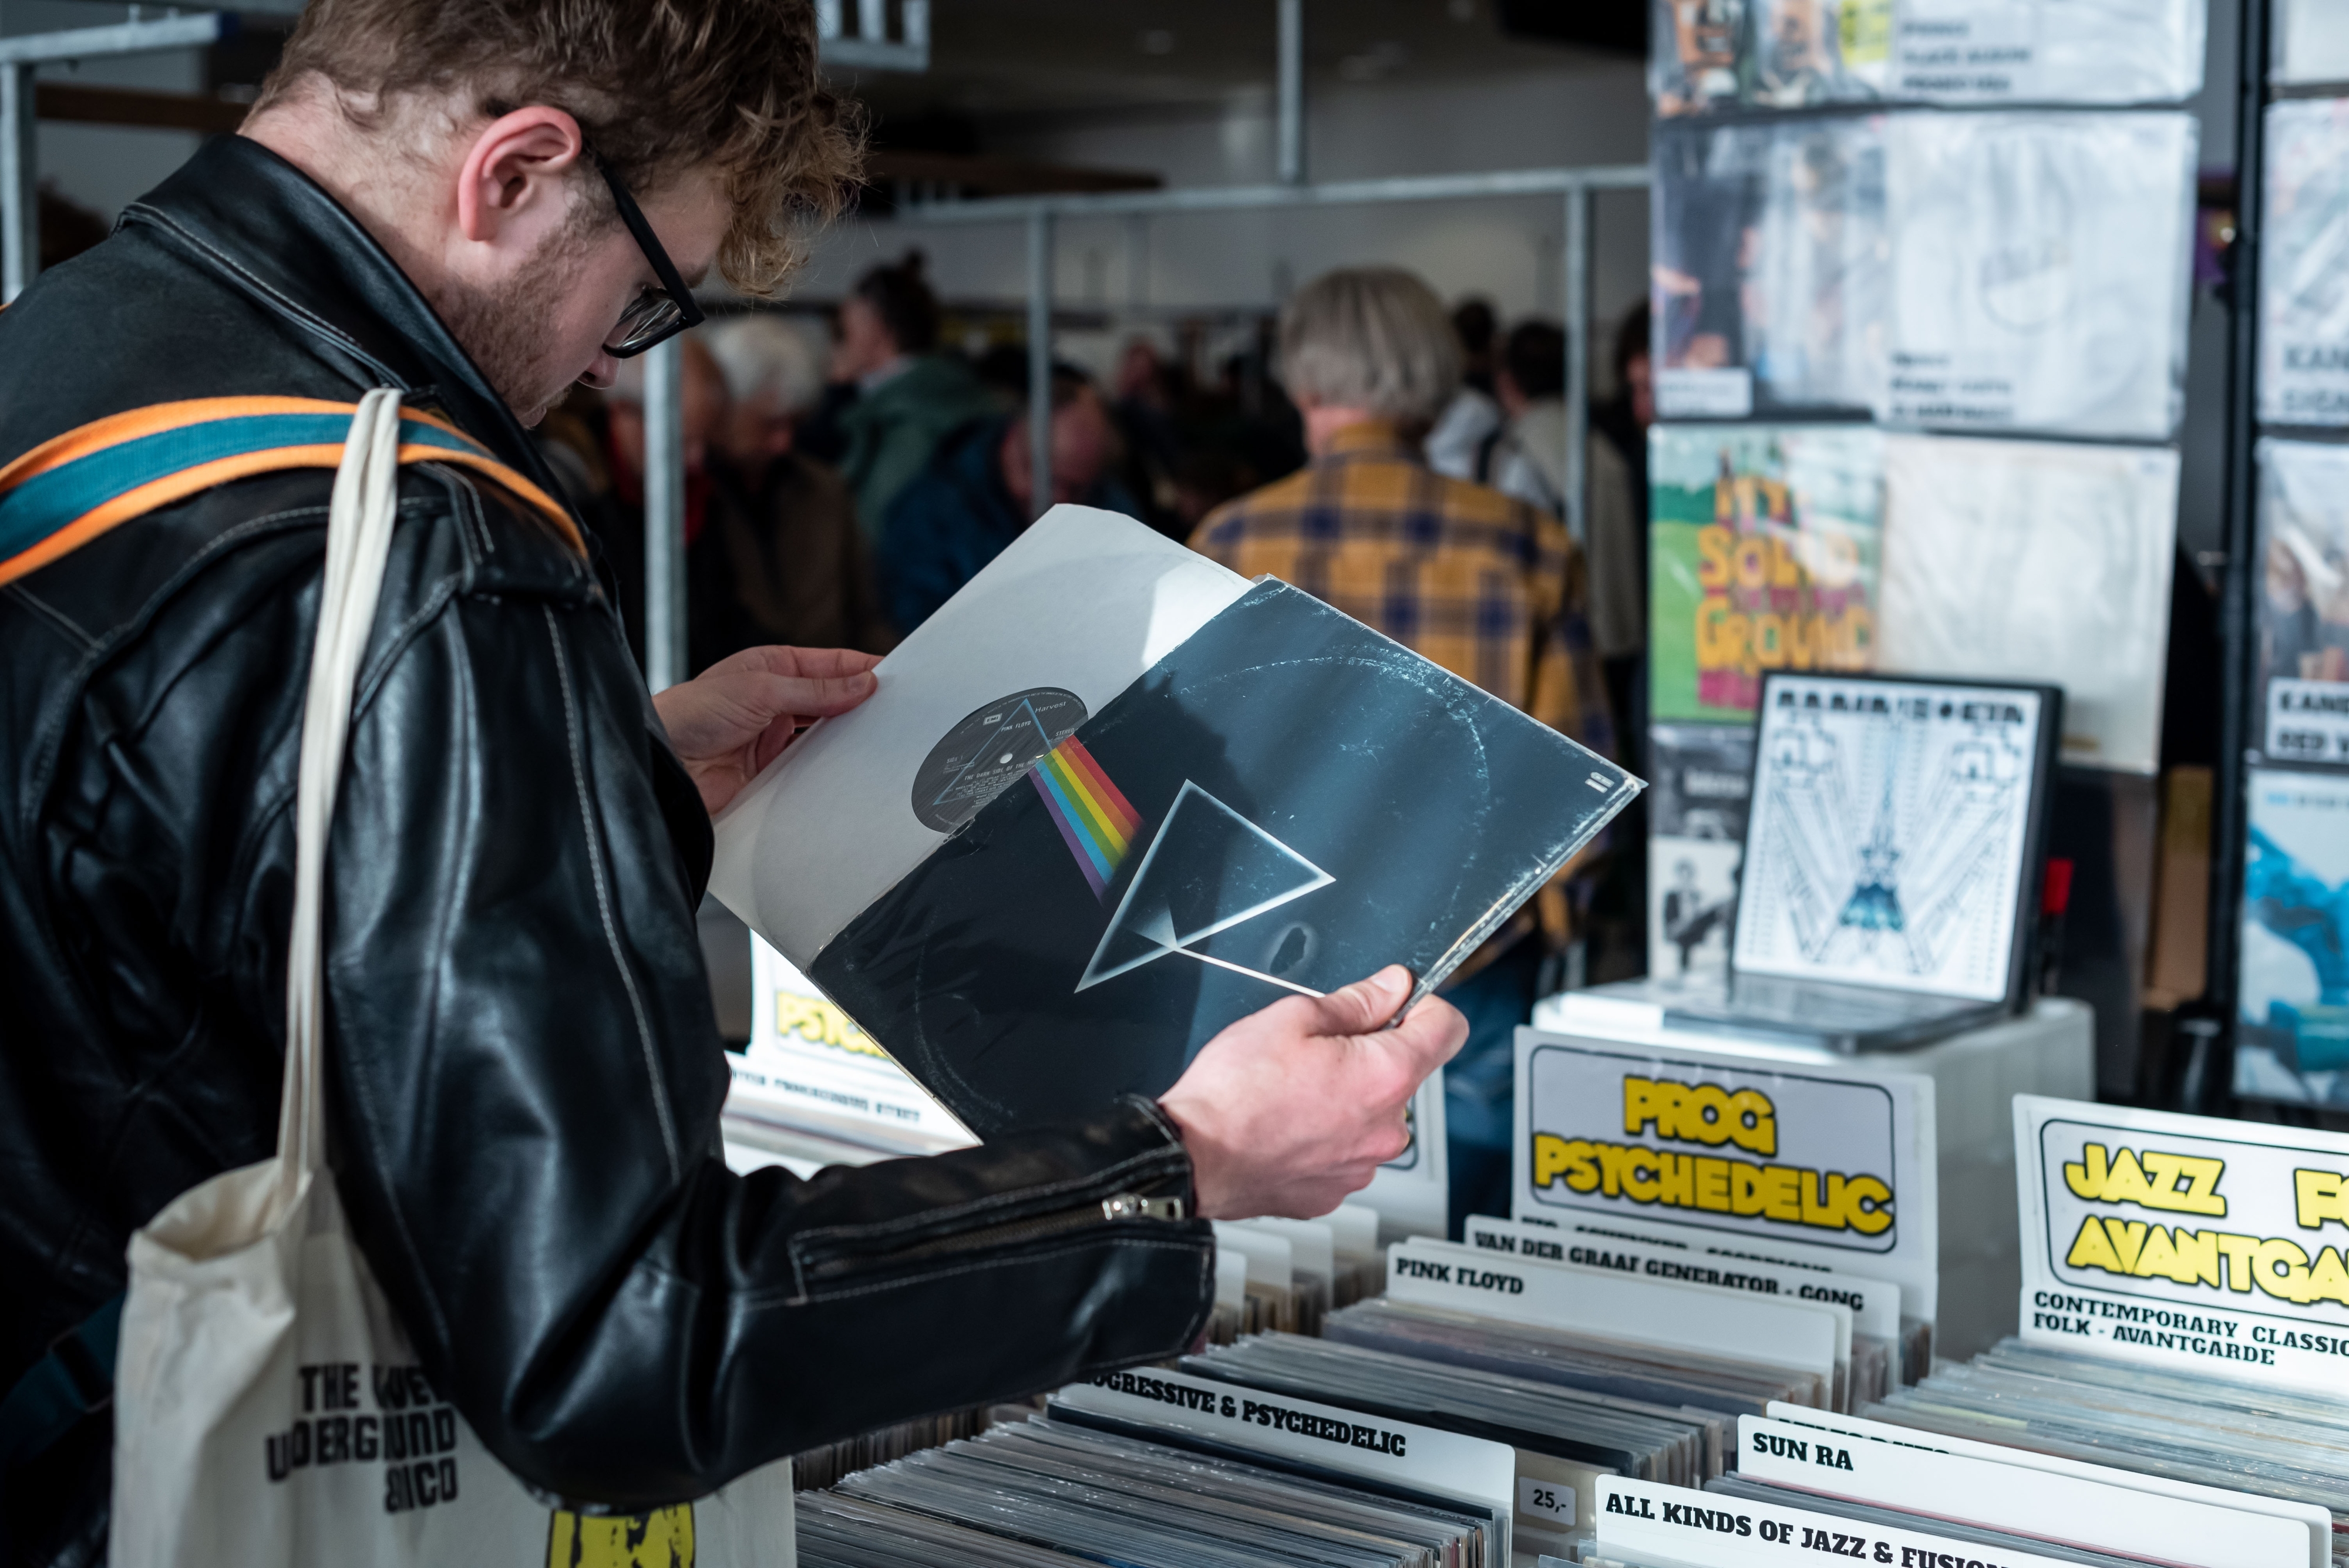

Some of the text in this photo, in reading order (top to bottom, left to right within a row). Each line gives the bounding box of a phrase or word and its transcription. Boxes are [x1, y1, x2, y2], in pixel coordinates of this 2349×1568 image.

[1015, 721, 1031, 729] FLOYD
[1035, 701, 1066, 713] Harvest
[1055, 728, 1075, 736] STEREO
[1623, 1073, 1778, 1158] PROG
[1532, 1130, 1896, 1237] PSYCHEDELIC
[2062, 1141, 2229, 1219] JAZZ
[1395, 1257, 1525, 1295] PINK FLOYD
[1474, 1230, 1516, 1253] VAN
[1521, 1238, 1563, 1261] DER
[1568, 1246, 1641, 1273] GRAAF
[1644, 1259, 1779, 1296] GENERATOR
[2065, 1213, 2349, 1307] AVANTGA
[2033, 1311, 2092, 1336] FOLK
[2112, 1325, 2276, 1366] AVANTGARDE
[2034, 1291, 2240, 1340] CONTEMPORARY
[298, 1362, 360, 1412] THE
[1076, 1371, 1407, 1458] OGRESSIVE & PSYCHEDELIC
[1752, 1432, 1808, 1462] SUN
[1815, 1444, 1855, 1472] RA
[1533, 1488, 1567, 1513] 25,-
[1604, 1492, 1656, 1520] ALL
[1662, 1502, 1752, 1537] KINDS
[1758, 1519, 1794, 1546] OF
[1801, 1526, 1866, 1560] JAZZ
[1873, 1541, 1893, 1564] &
